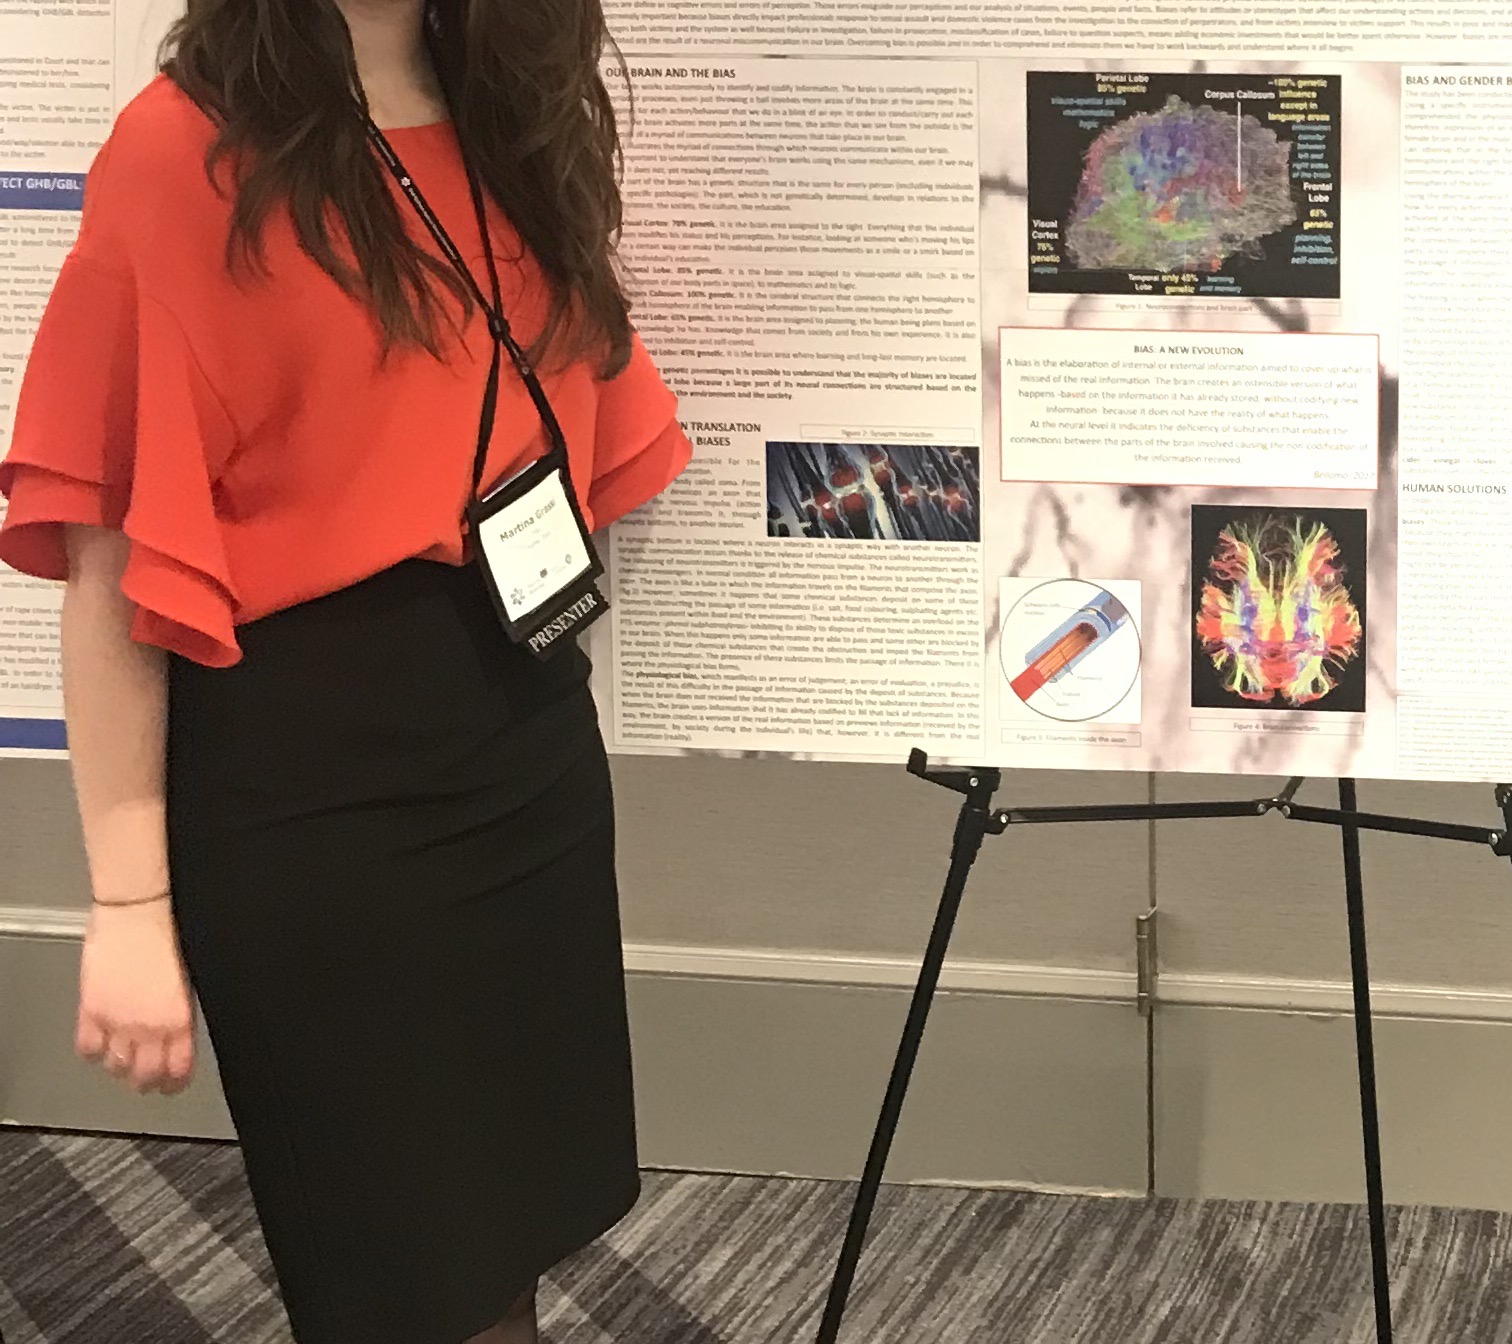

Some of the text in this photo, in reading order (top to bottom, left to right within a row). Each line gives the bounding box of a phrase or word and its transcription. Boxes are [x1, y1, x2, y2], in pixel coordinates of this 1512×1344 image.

[1405, 75, 1429, 85] BIAS
[1432, 75, 1456, 85] AND
[1458, 75, 1502, 85] GENDER
[1159, 345, 1165, 353] A
[1168, 346, 1189, 354] NEW
[1192, 346, 1244, 355] EVOLUTION
[1402, 483, 1506, 494] HUMAN SOLUTIONS
[500, 516, 535, 543] Martina
[528, 592, 598, 653] PRESENTER
